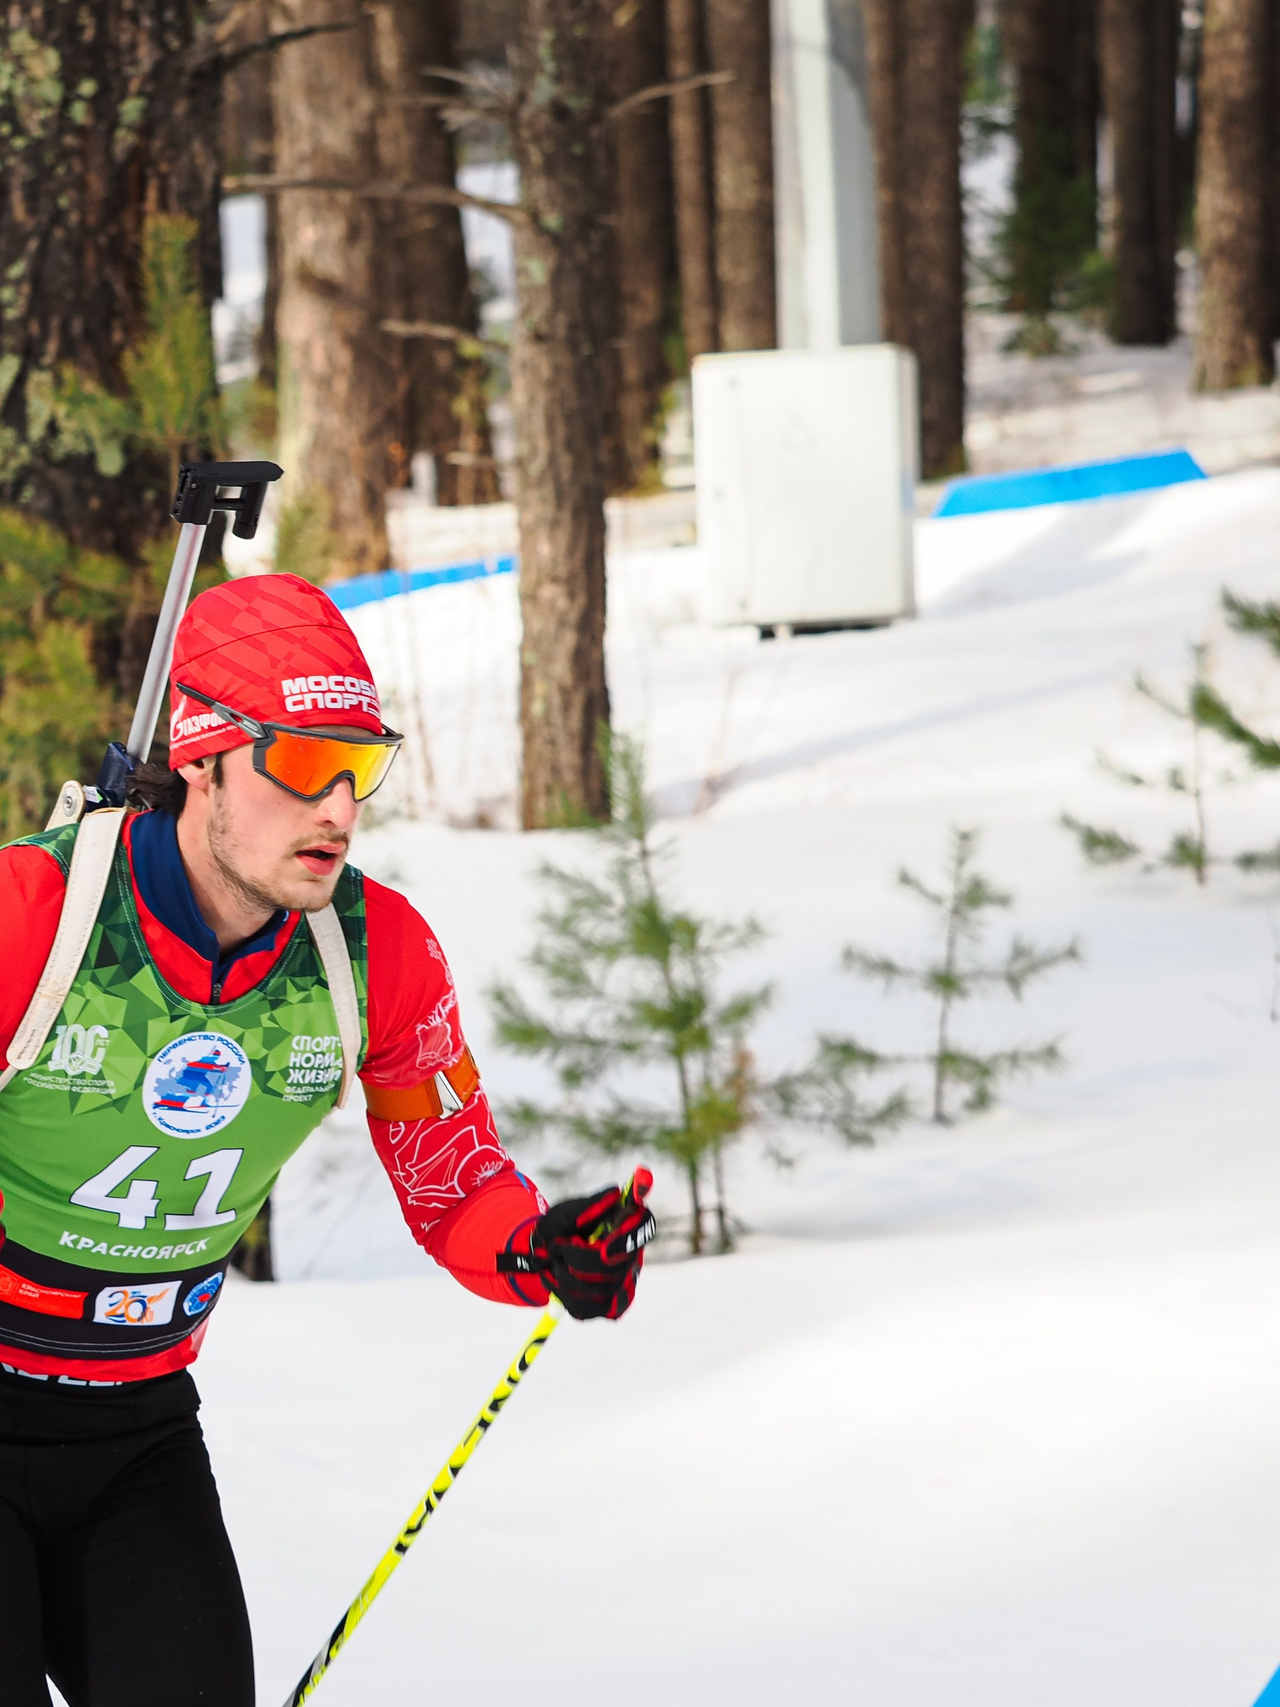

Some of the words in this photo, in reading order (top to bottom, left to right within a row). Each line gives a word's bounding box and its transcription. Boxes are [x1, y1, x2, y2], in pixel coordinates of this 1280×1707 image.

[284, 692, 372, 713] СПОРТ
[157, 1034, 216, 1062] ПЕРВЕНСТВО
[217, 1036, 246, 1065] РОССИИ
[291, 1035, 341, 1052] СПОРТ-
[70, 1145, 244, 1231] 41
[59, 1231, 209, 1260] КРАСНОЯРСК
